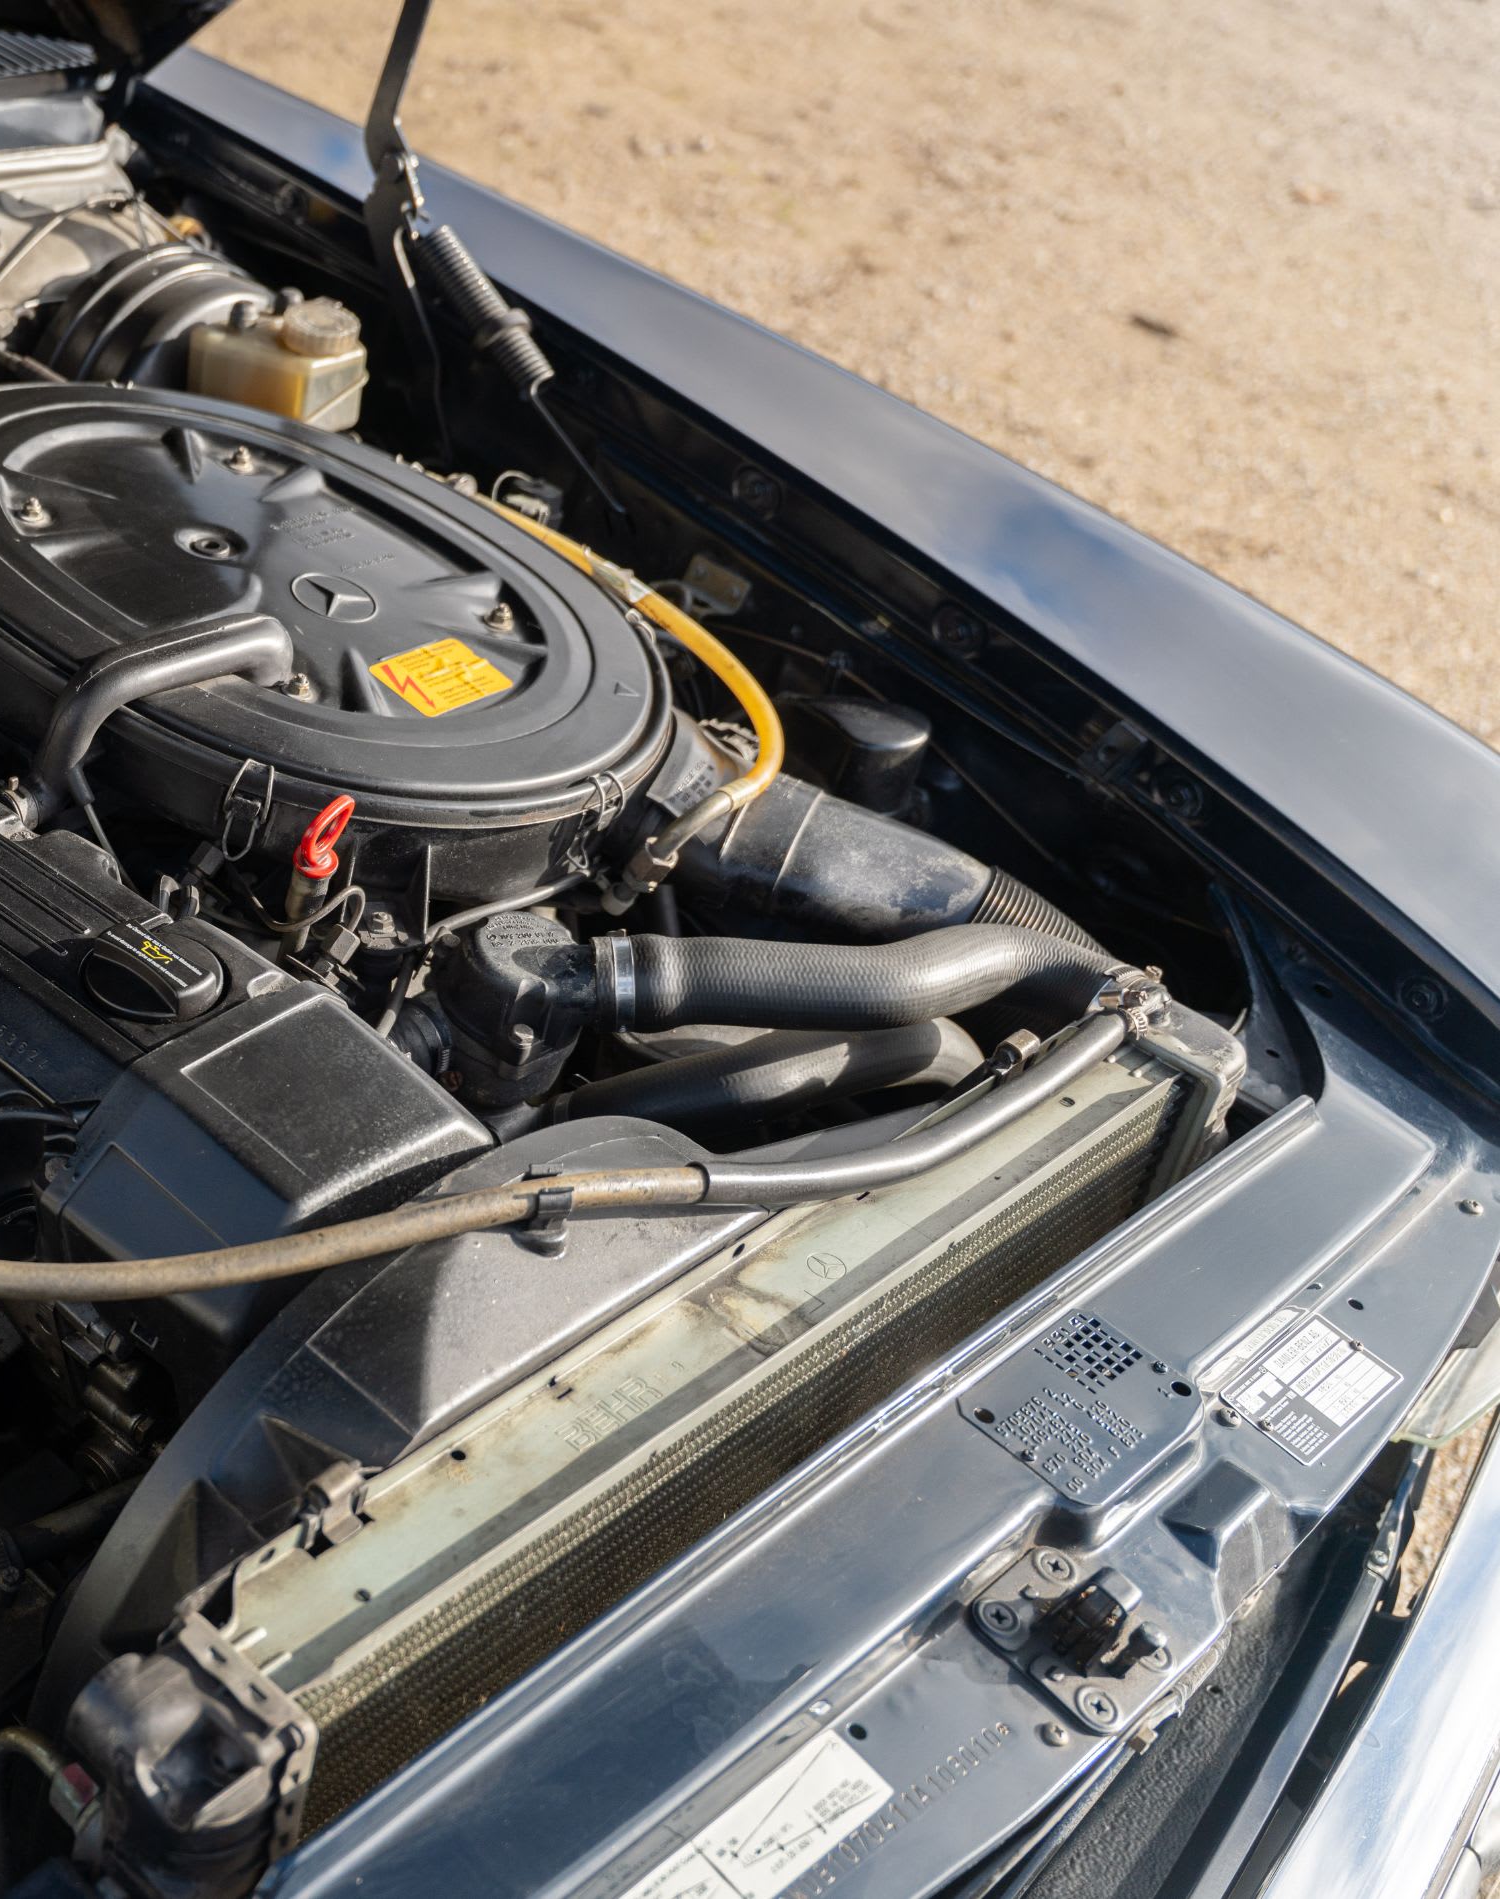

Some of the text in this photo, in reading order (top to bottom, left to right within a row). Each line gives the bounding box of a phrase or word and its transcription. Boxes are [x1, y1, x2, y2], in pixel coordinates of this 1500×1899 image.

[554, 1376, 664, 1453] BEHR
[995, 1396, 1045, 1438] 9705876
[1012, 1403, 1057, 1444] 107041
